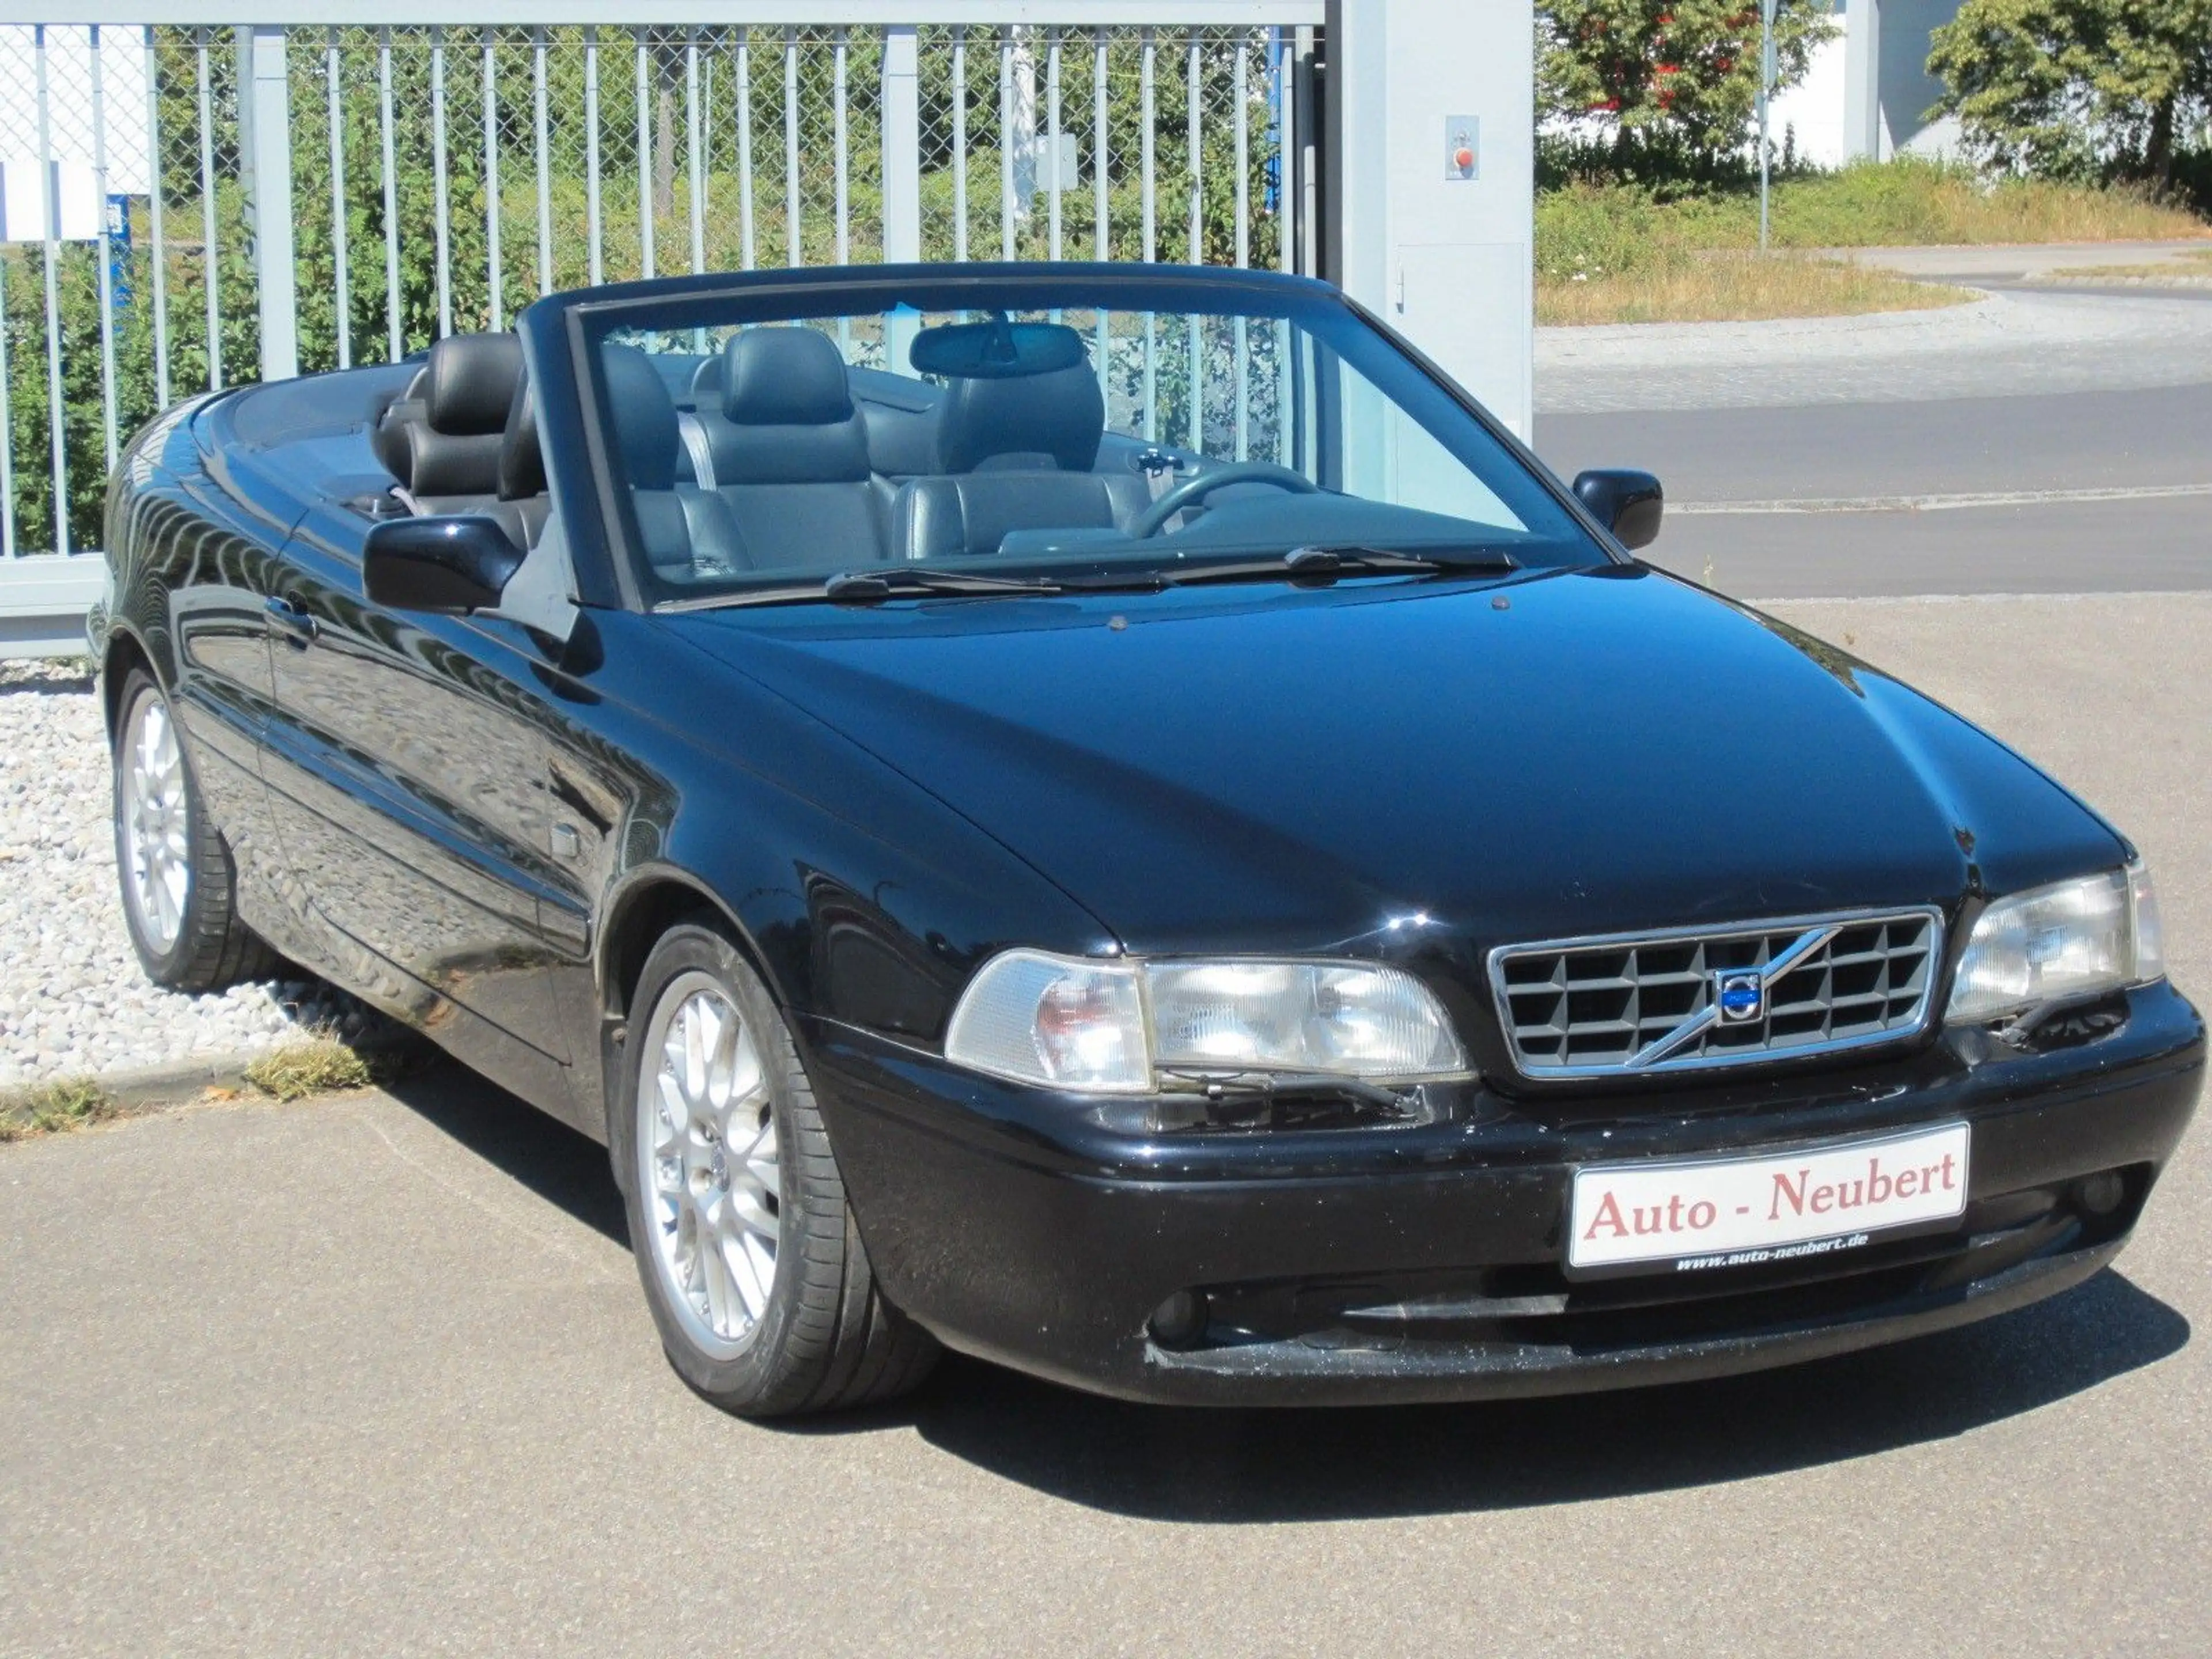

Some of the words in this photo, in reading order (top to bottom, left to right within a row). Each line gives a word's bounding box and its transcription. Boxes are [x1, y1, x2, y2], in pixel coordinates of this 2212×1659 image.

[1583, 1191, 1717, 1240] Auto
[1736, 1205, 1750, 1215] -
[1768, 1153, 1956, 1221] Neubert
[1677, 1233, 1869, 1270] www.auto-neubert.de
